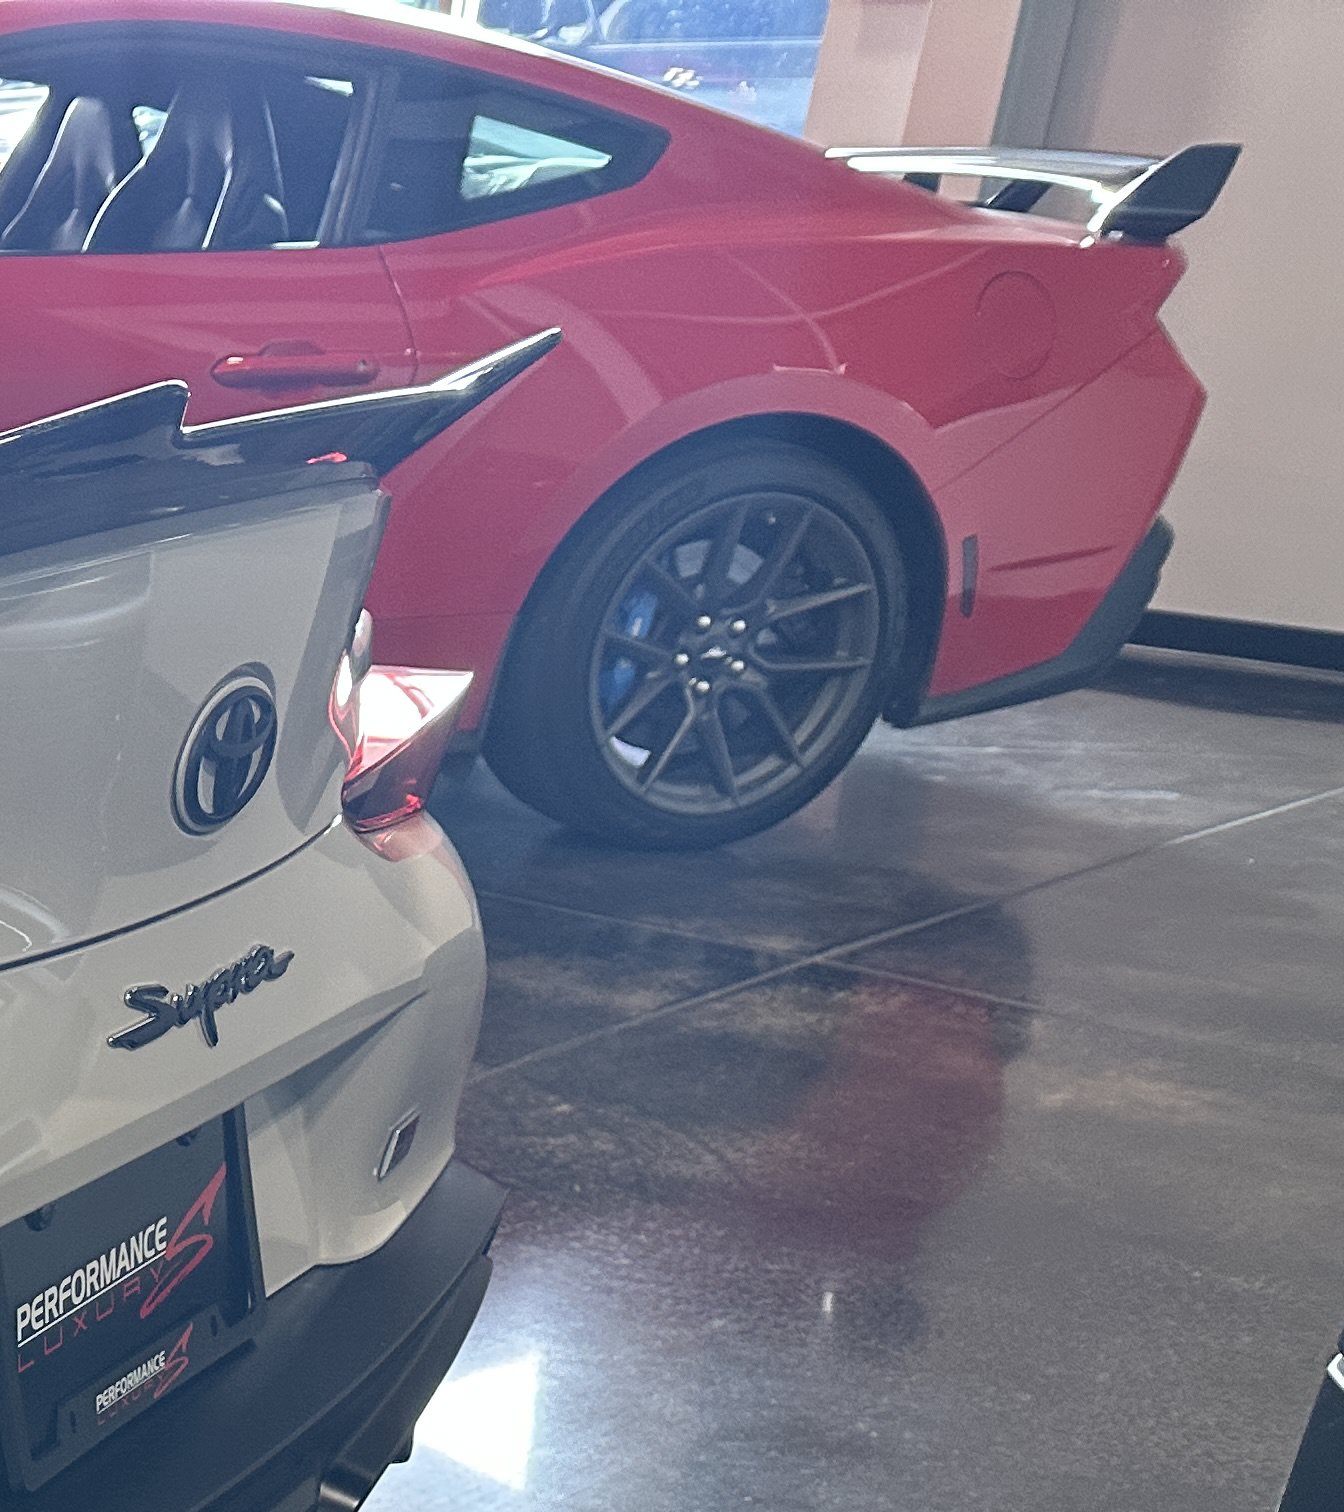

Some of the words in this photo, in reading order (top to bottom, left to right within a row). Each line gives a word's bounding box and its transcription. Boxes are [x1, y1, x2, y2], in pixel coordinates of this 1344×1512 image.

[107, 944, 295, 1049] Supra
[16, 1216, 168, 1342] PERFORMANCE
[18, 1261, 180, 1373] LUXURY
[96, 1350, 166, 1412] PERFORMANCE
